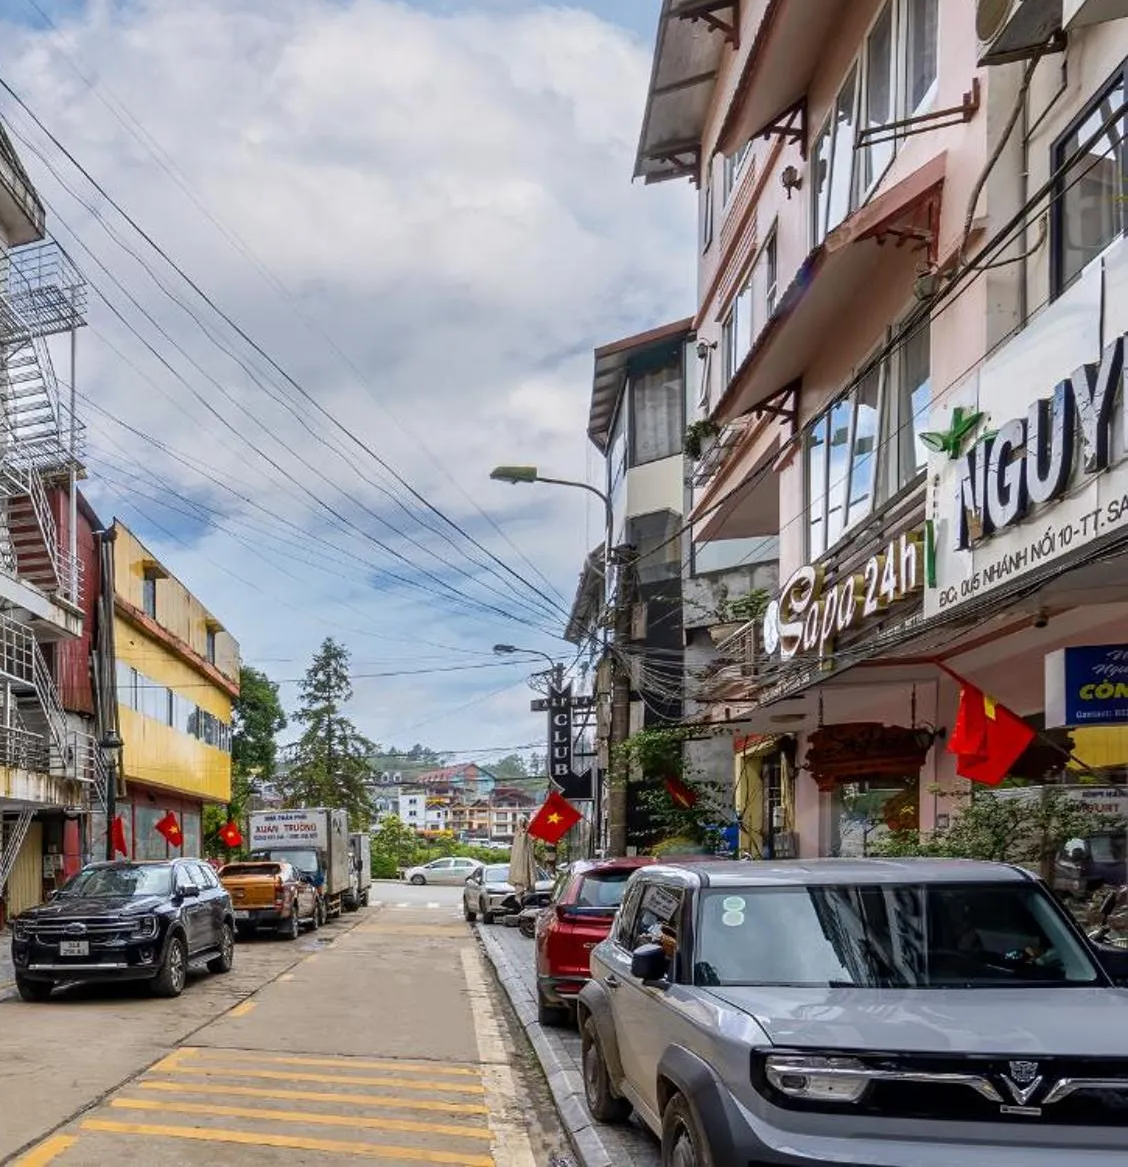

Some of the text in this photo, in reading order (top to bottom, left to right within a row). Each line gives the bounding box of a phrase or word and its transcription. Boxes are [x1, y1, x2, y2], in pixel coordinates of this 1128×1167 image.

[953, 330, 1128, 552] NGUY
[863, 533, 917, 617] 24h
[982, 548, 1028, 586] NHÁNH
[553, 713, 569, 776] CLUB
